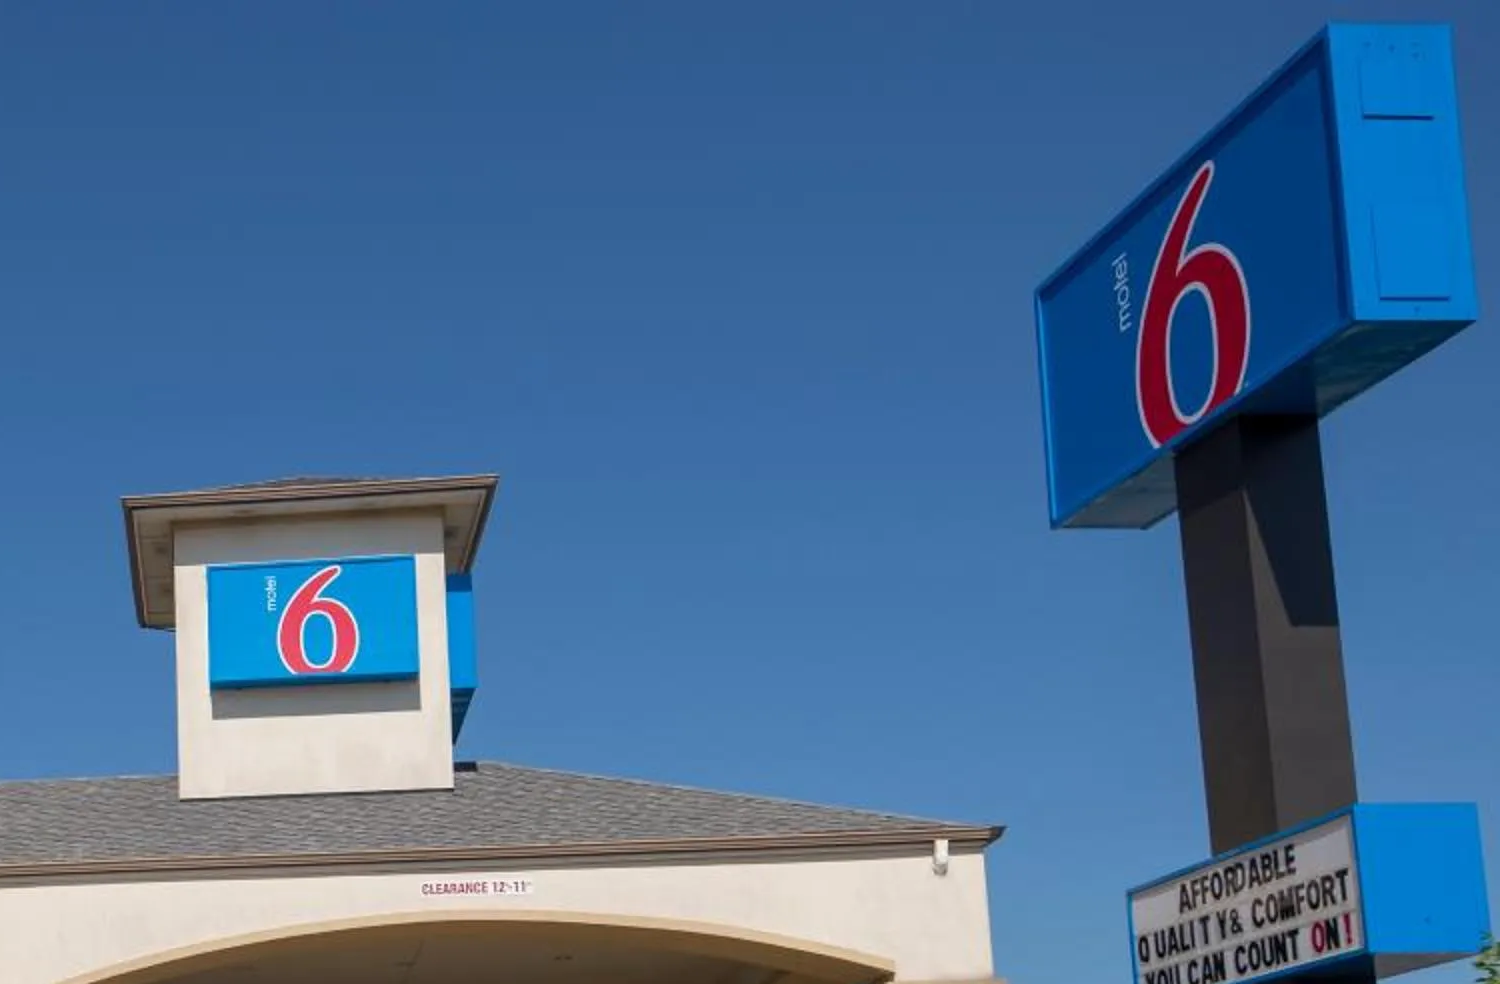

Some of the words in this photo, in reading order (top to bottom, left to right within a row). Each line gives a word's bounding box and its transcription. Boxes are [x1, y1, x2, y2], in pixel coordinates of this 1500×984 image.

[1112, 252, 1132, 332] motel
[1136, 160, 1250, 449] 6
[264, 575, 277, 612] motel
[277, 565, 360, 675] 6
[421, 881, 489, 895] CLEARANCE
[1178, 845, 1296, 914] AFFORDABLE
[1252, 867, 1349, 928] COMFORT
[1235, 929, 1300, 975] COUNT
[1311, 914, 1353, 953] ON!
